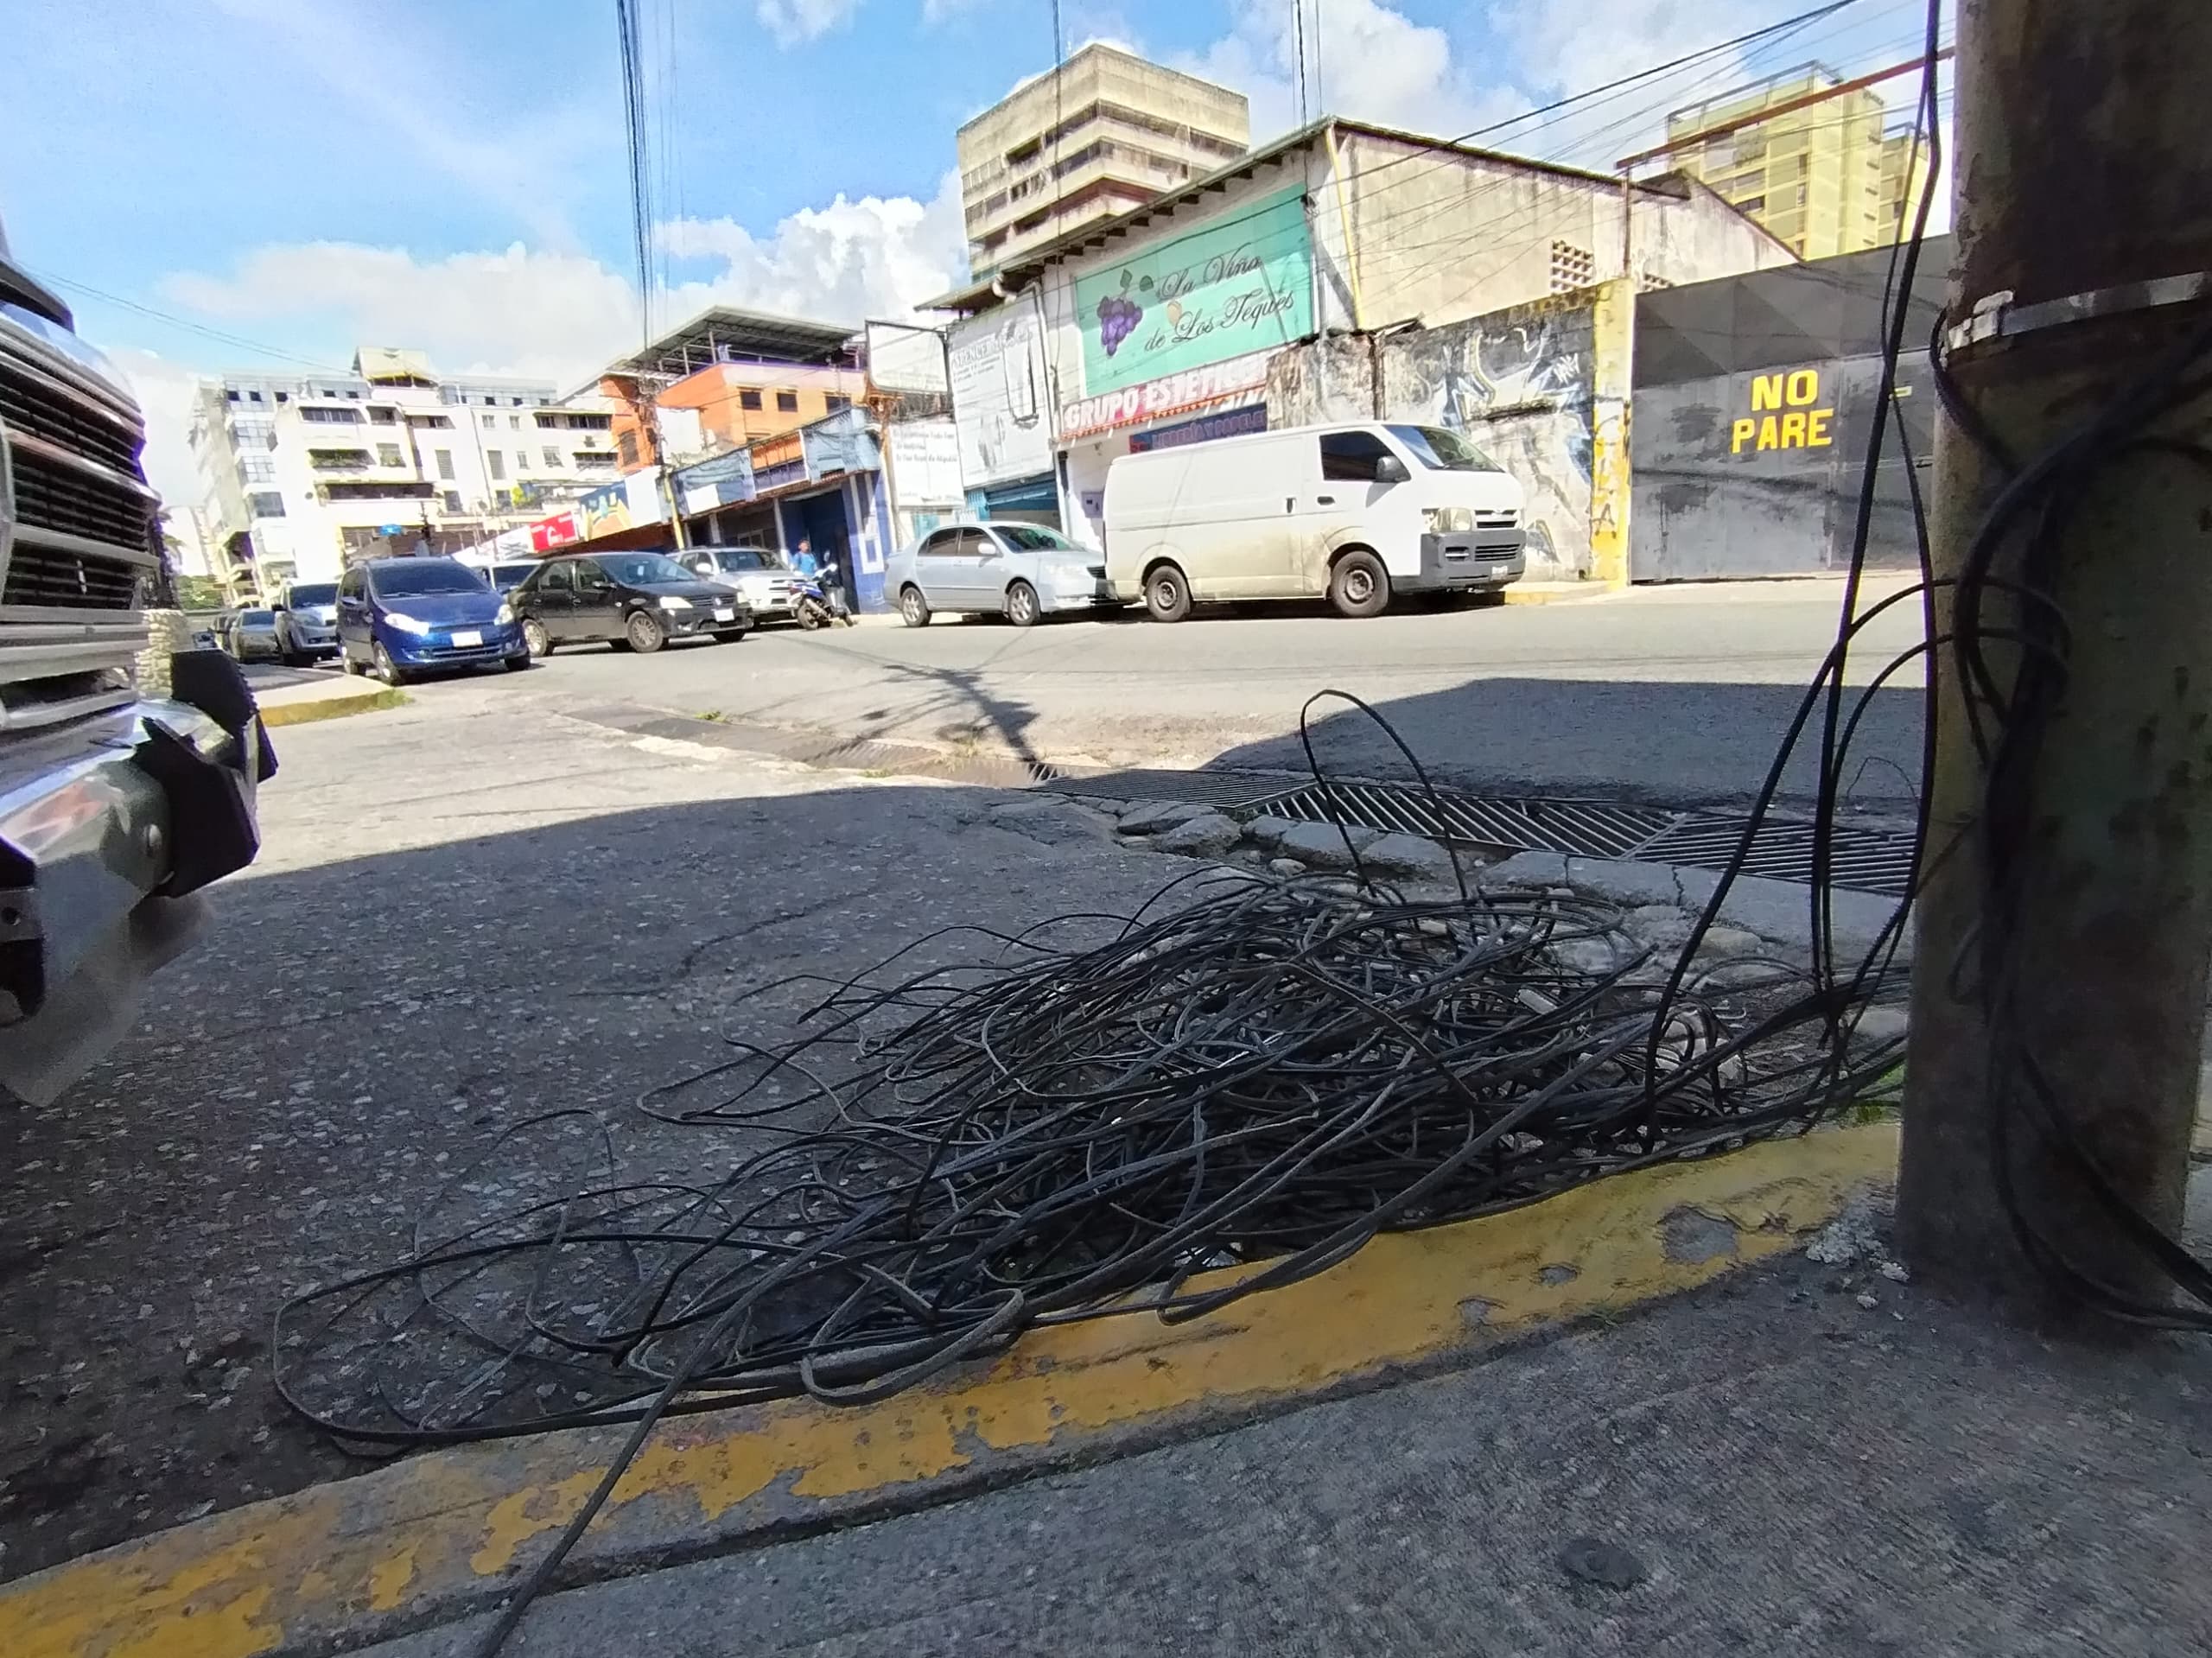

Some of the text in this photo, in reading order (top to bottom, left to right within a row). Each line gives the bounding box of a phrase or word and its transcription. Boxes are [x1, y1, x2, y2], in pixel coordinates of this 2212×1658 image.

[1155, 243, 1262, 302] La Viña
[1144, 289, 1294, 352] de Los Teques
[1063, 388, 1140, 430] GRUPO
[1751, 370, 1818, 411] NO
[1732, 408, 1834, 454] PARE
